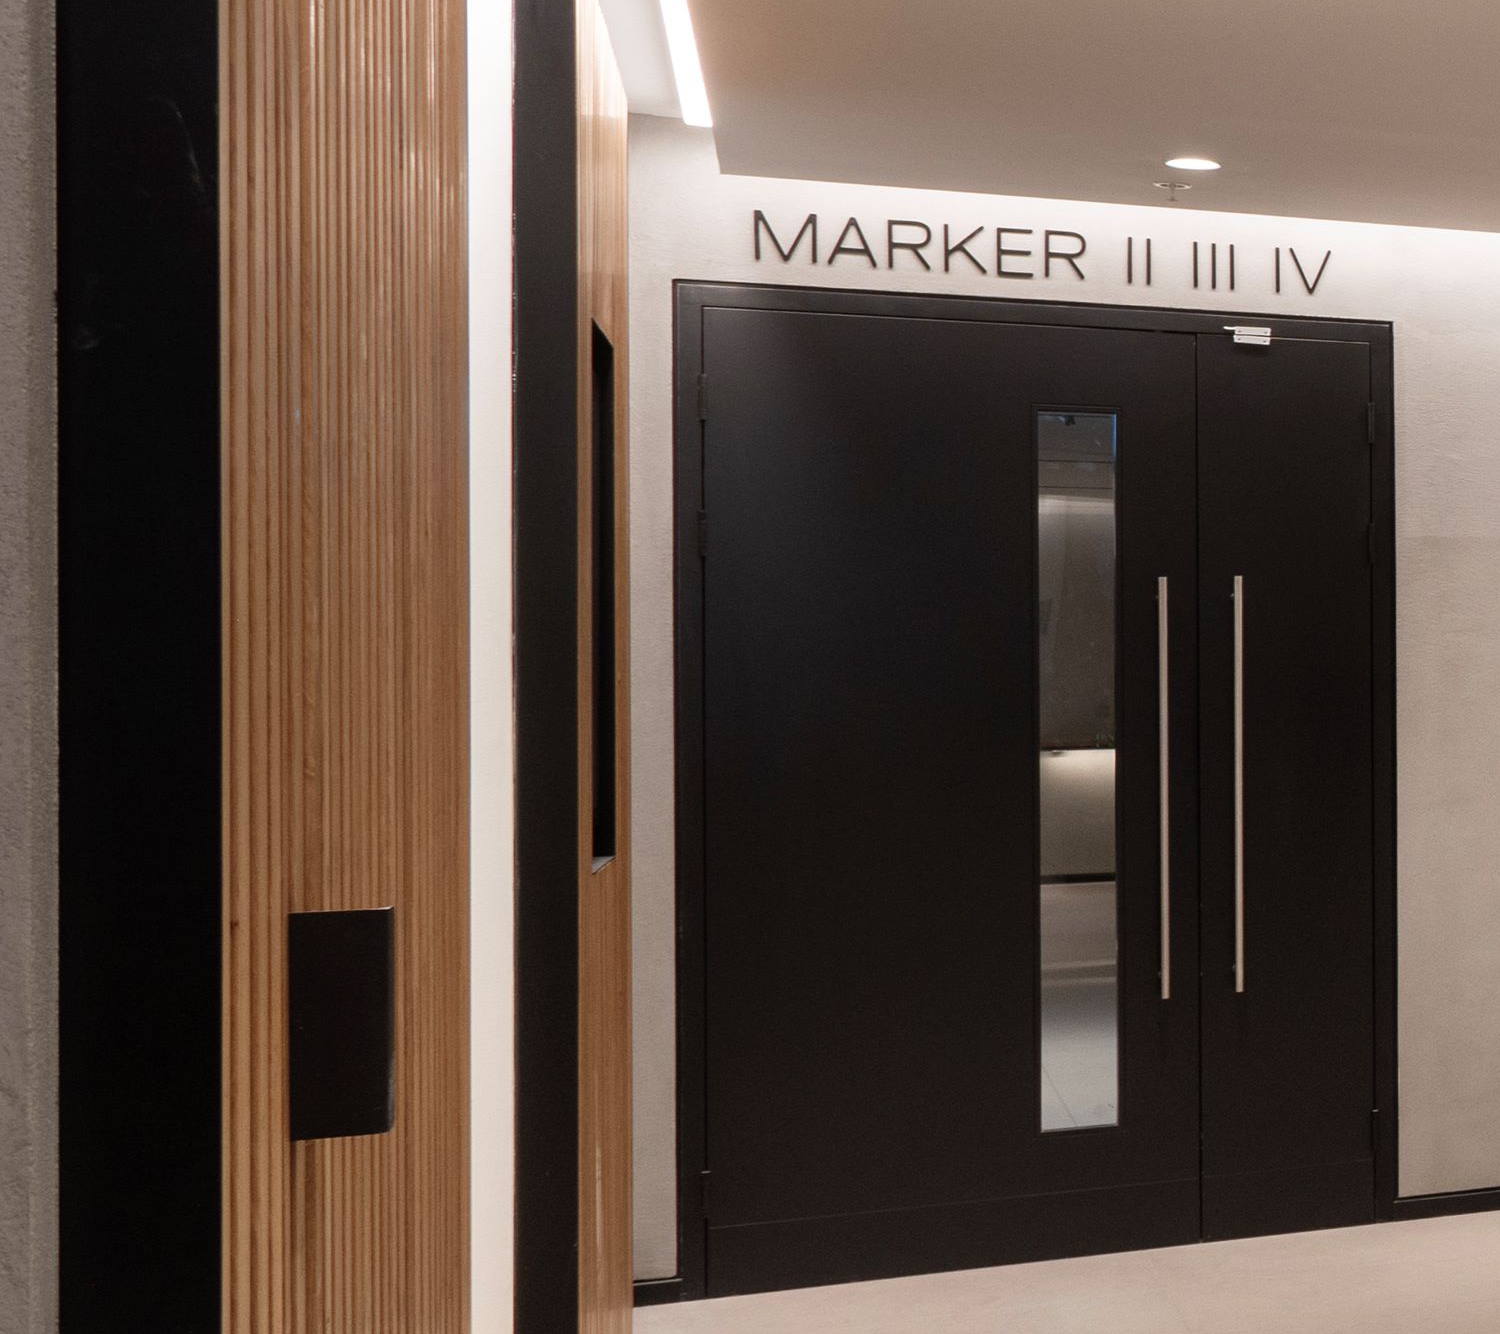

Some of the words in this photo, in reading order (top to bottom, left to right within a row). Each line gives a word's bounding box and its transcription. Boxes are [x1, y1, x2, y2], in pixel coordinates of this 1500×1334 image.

[752, 208, 1088, 282] MARKER
[1126, 236, 1153, 287] II
[1192, 240, 1236, 292] III
[1274, 246, 1332, 297] IV
